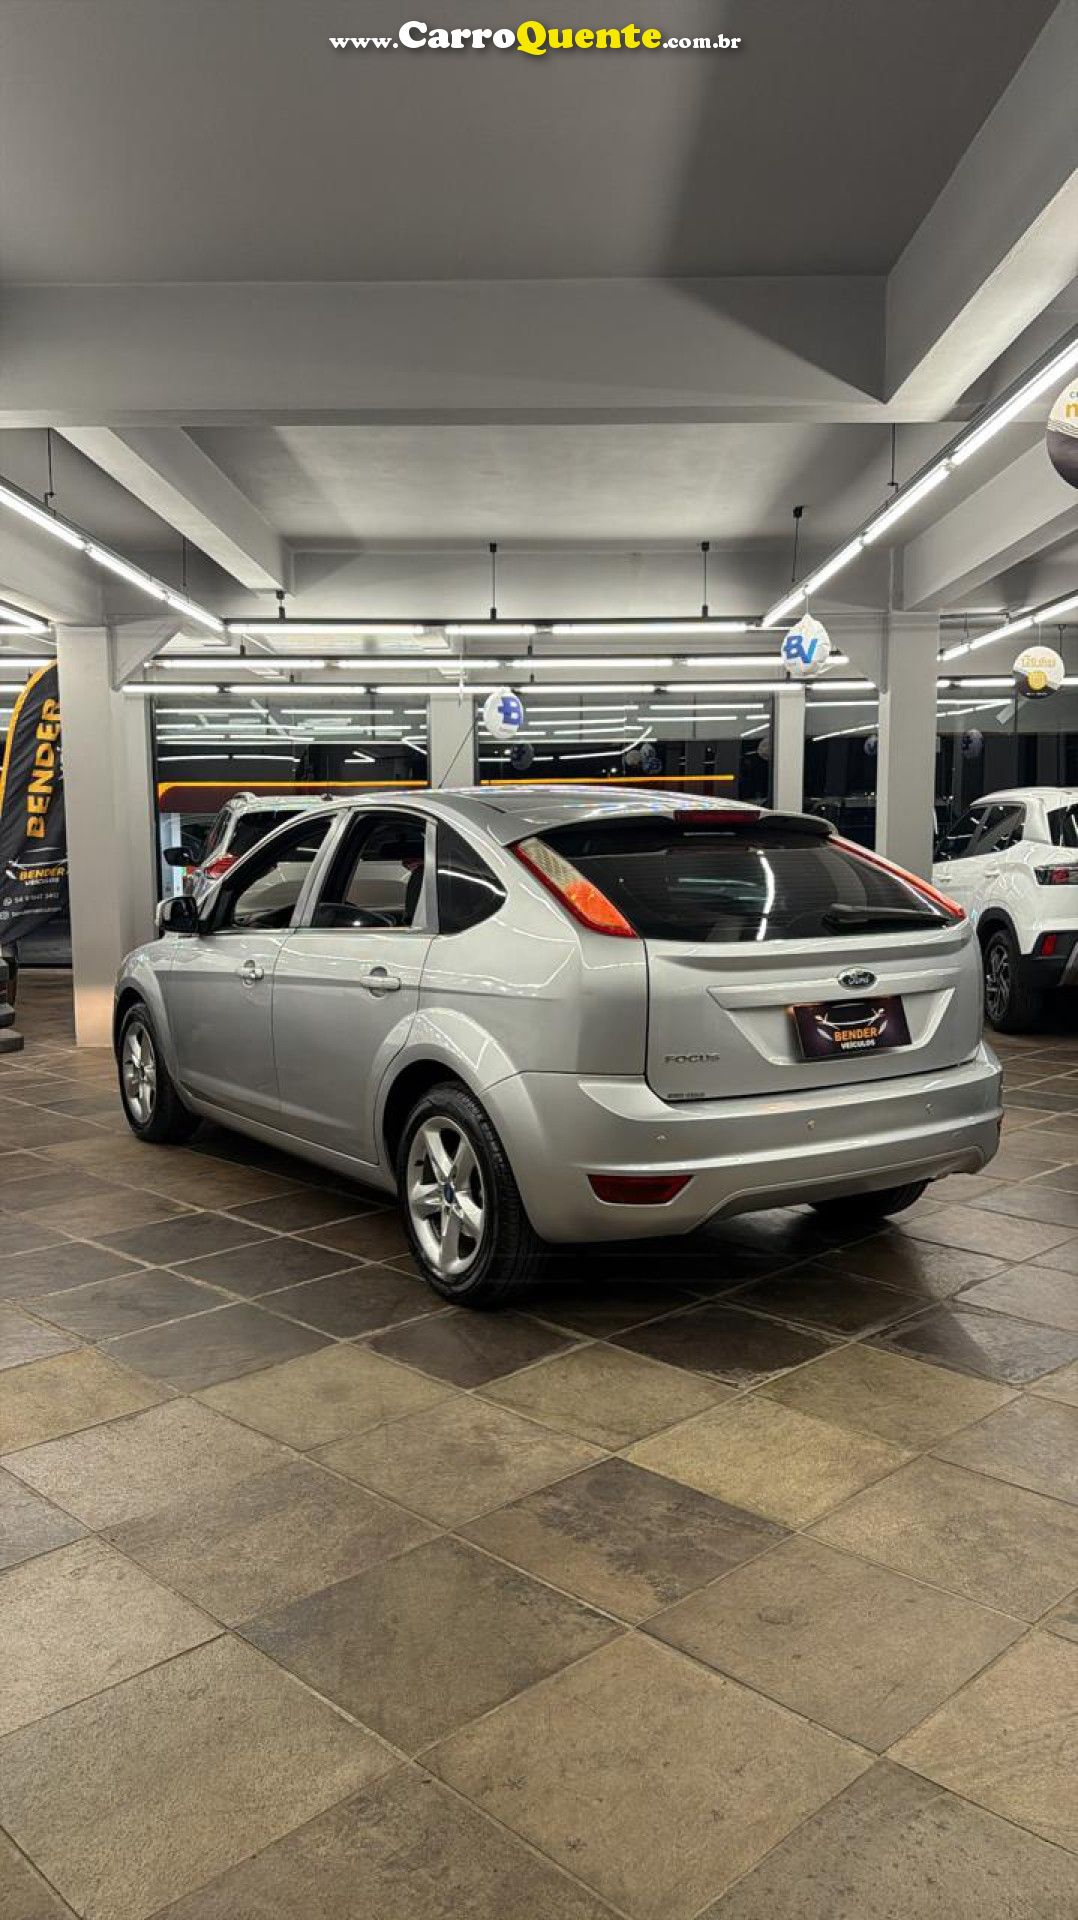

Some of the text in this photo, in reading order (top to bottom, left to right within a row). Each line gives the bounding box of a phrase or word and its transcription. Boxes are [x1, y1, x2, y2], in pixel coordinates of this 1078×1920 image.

[26, 698, 62, 839] BENDER
[19, 867, 66, 881] BENDER
[833, 1027, 878, 1042] BENDER
[664, 1053, 721, 1064] FOCUS
